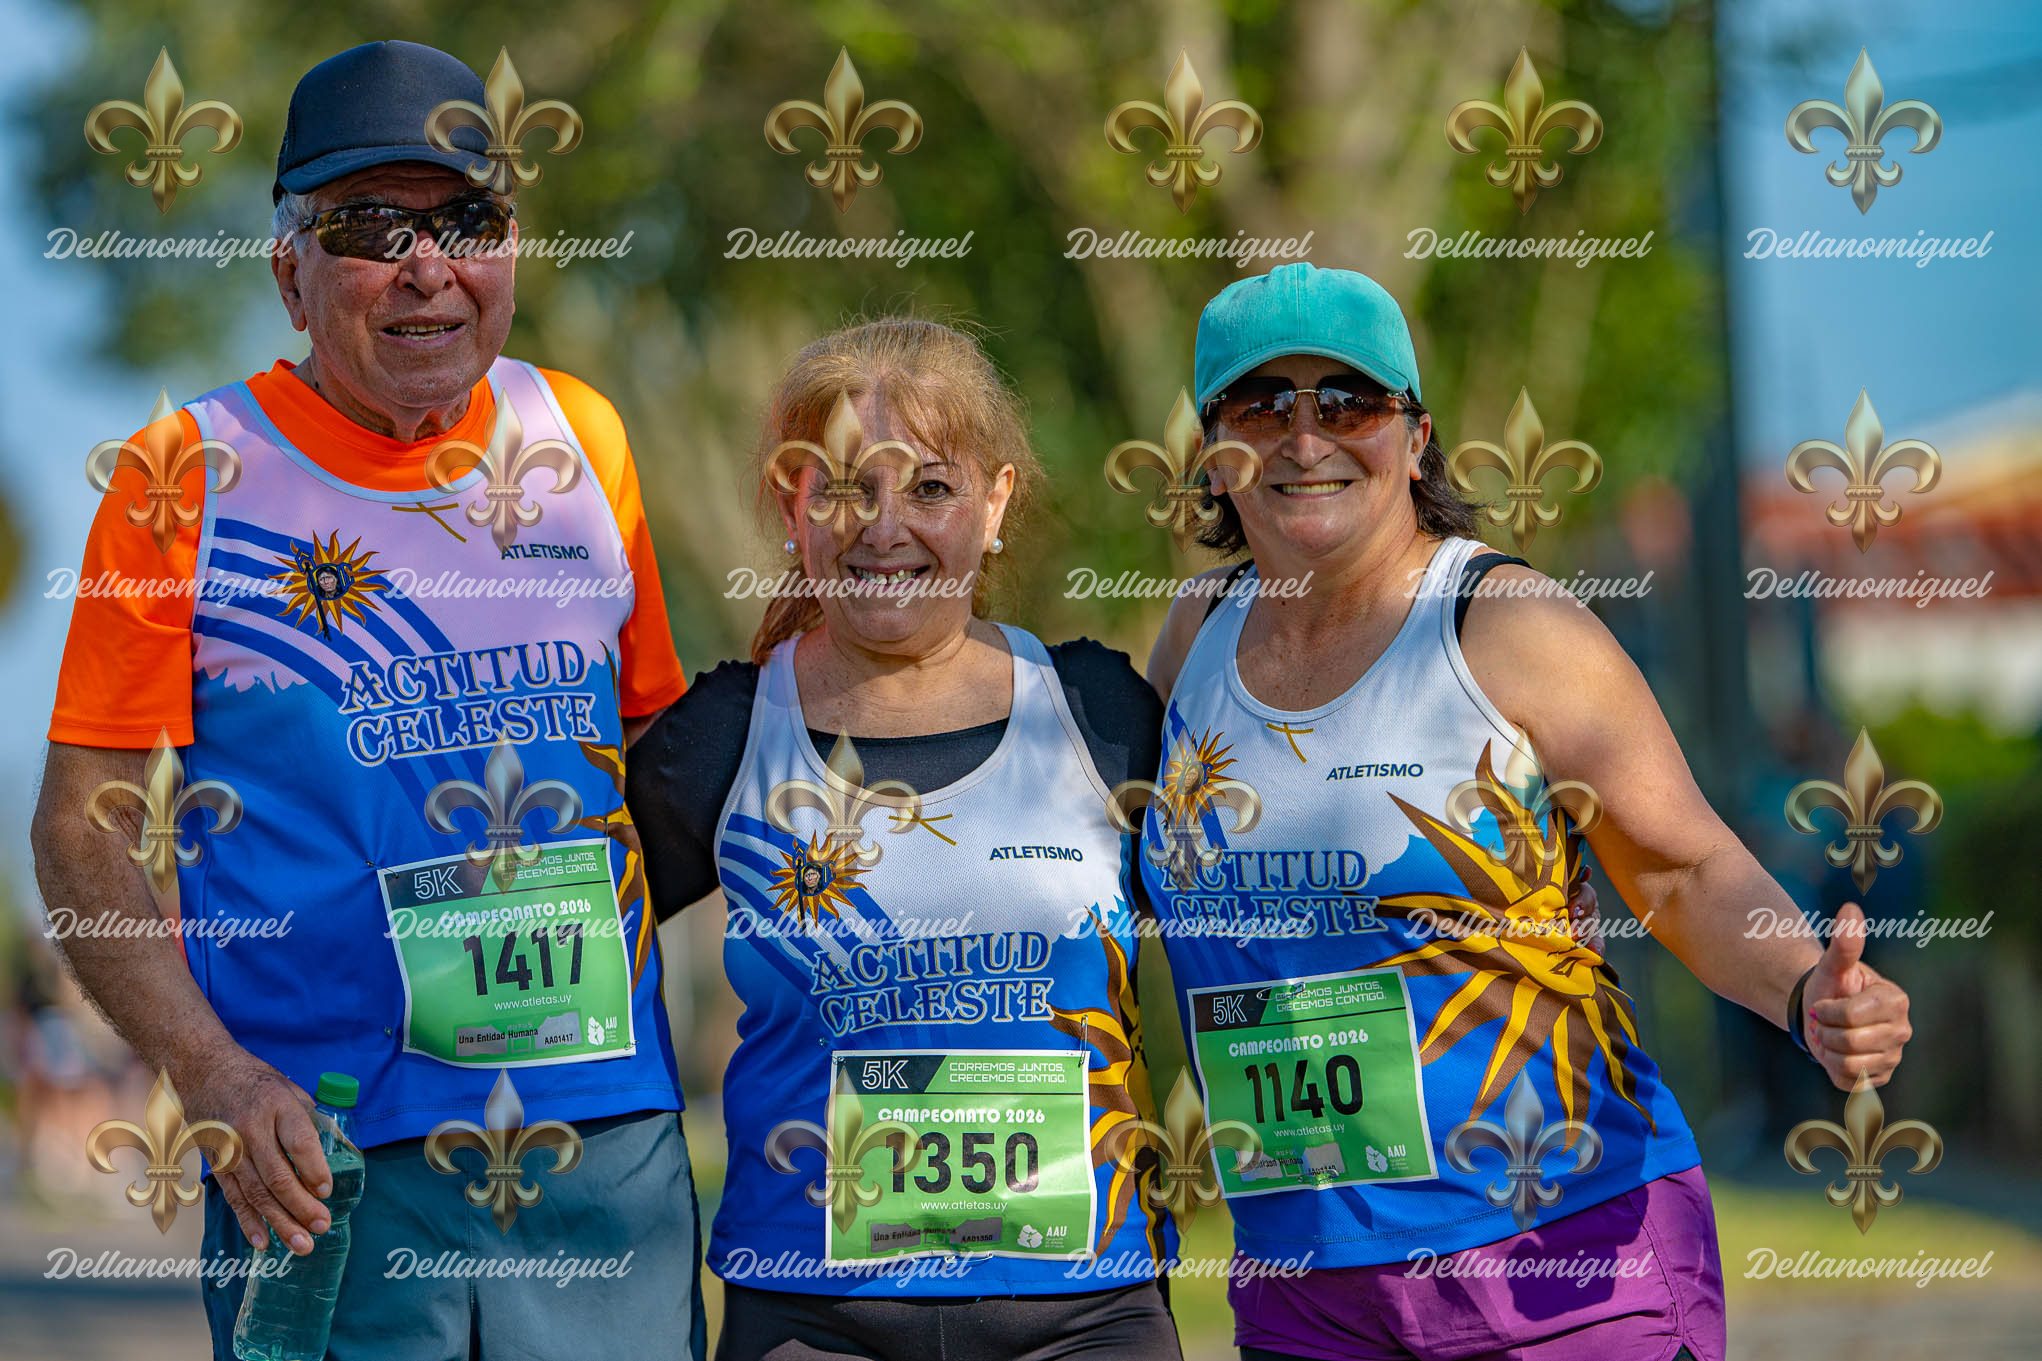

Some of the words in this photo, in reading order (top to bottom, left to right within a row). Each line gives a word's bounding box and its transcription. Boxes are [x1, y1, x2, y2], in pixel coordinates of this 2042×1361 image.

[501, 543, 589, 561] ATLETISMO
[337, 639, 587, 714] ACTITUD
[346, 694, 600, 767] CELESTE
[1326, 763, 1423, 782] ATLETISMO
[499, 854, 563, 871] CORREMOS
[989, 845, 1084, 863] ATLETISMO
[502, 866, 564, 881] CRECEMOS
[1160, 849, 1370, 892] ACTITUD
[414, 865, 463, 899] 5K
[439, 902, 556, 930] CAMPEONATO
[558, 898, 591, 916] 2026
[1172, 895, 1388, 939] CELESTE
[463, 922, 583, 996] 1417
[810, 931, 1053, 997] ACTITUD
[1335, 980, 1383, 995] JUNTOS,
[494, 993, 572, 1011] www.atletas.uy
[819, 977, 1055, 1038] CELESTE
[1212, 994, 1248, 1025] 5K
[1276, 998, 1334, 1013] CRECEMOS
[1335, 991, 1387, 1005] CONTIGO.
[605, 1015, 618, 1030] AAU
[458, 1035, 474, 1044] Una
[477, 1031, 506, 1043] Entidad
[507, 1027, 539, 1039] Humana
[1228, 1034, 1323, 1058] CAMPEONATO
[1329, 1028, 1369, 1047] 2026
[861, 1060, 908, 1089] 5K
[949, 1062, 1015, 1073] CORREMOS
[1017, 1062, 1066, 1074] JUNTOS,
[949, 1073, 1015, 1083] CRECEMOS
[1017, 1073, 1068, 1083] CONTIGO.
[1244, 1054, 1364, 1124] 1140
[878, 1108, 1001, 1124] CAMPEONATO
[1005, 1109, 1045, 1124] 2026
[1273, 1122, 1345, 1138] www.atletas.uy
[1387, 1144, 1407, 1158] AAU
[885, 1131, 1039, 1194] 1350
[920, 1199, 1009, 1212] www.atletas.uy
[1046, 1225, 1068, 1238] AAU
